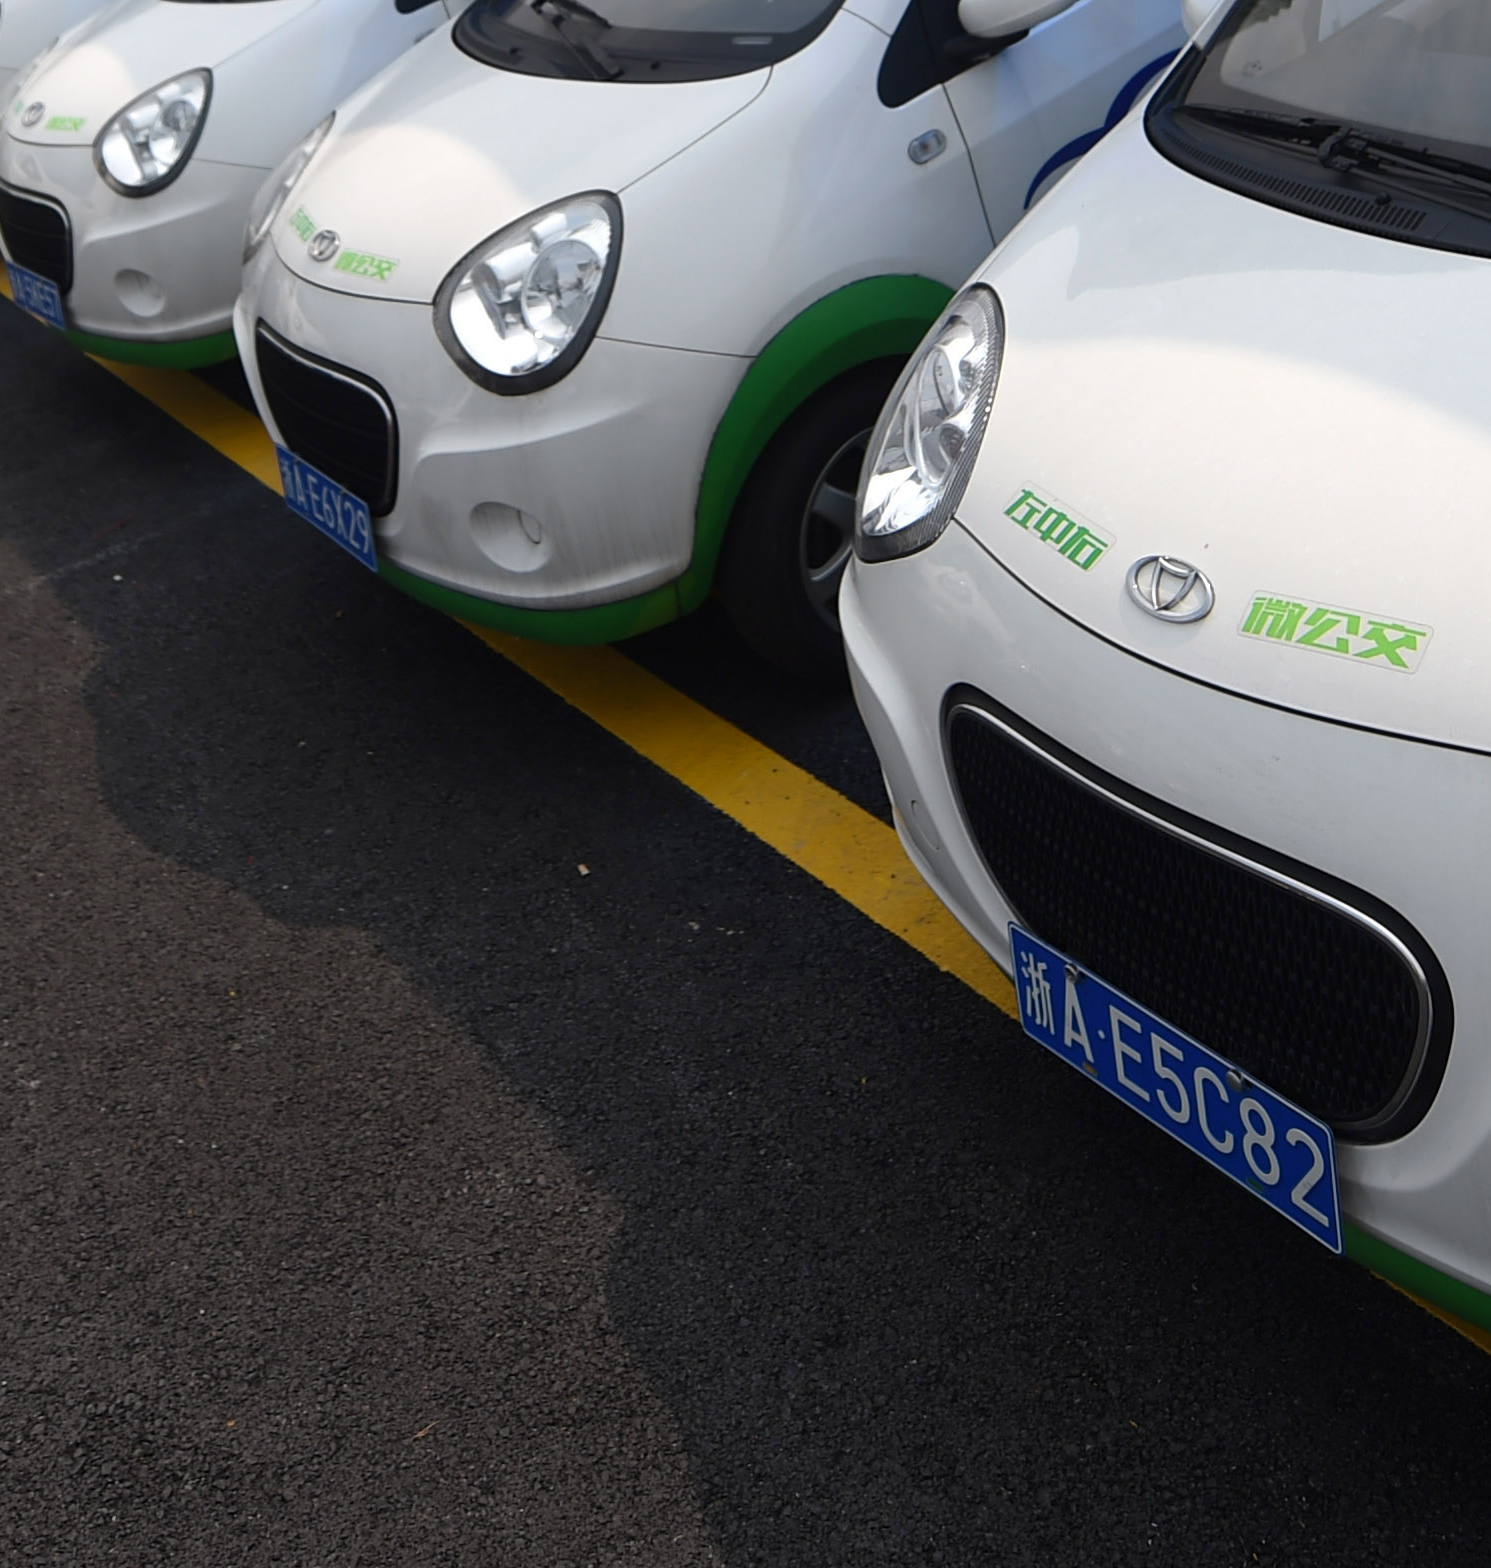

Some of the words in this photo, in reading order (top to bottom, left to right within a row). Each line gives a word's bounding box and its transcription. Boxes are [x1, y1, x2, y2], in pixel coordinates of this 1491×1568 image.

[1003, 488, 1109, 572] 左中右
[1240, 596, 1428, 670] 微公交
